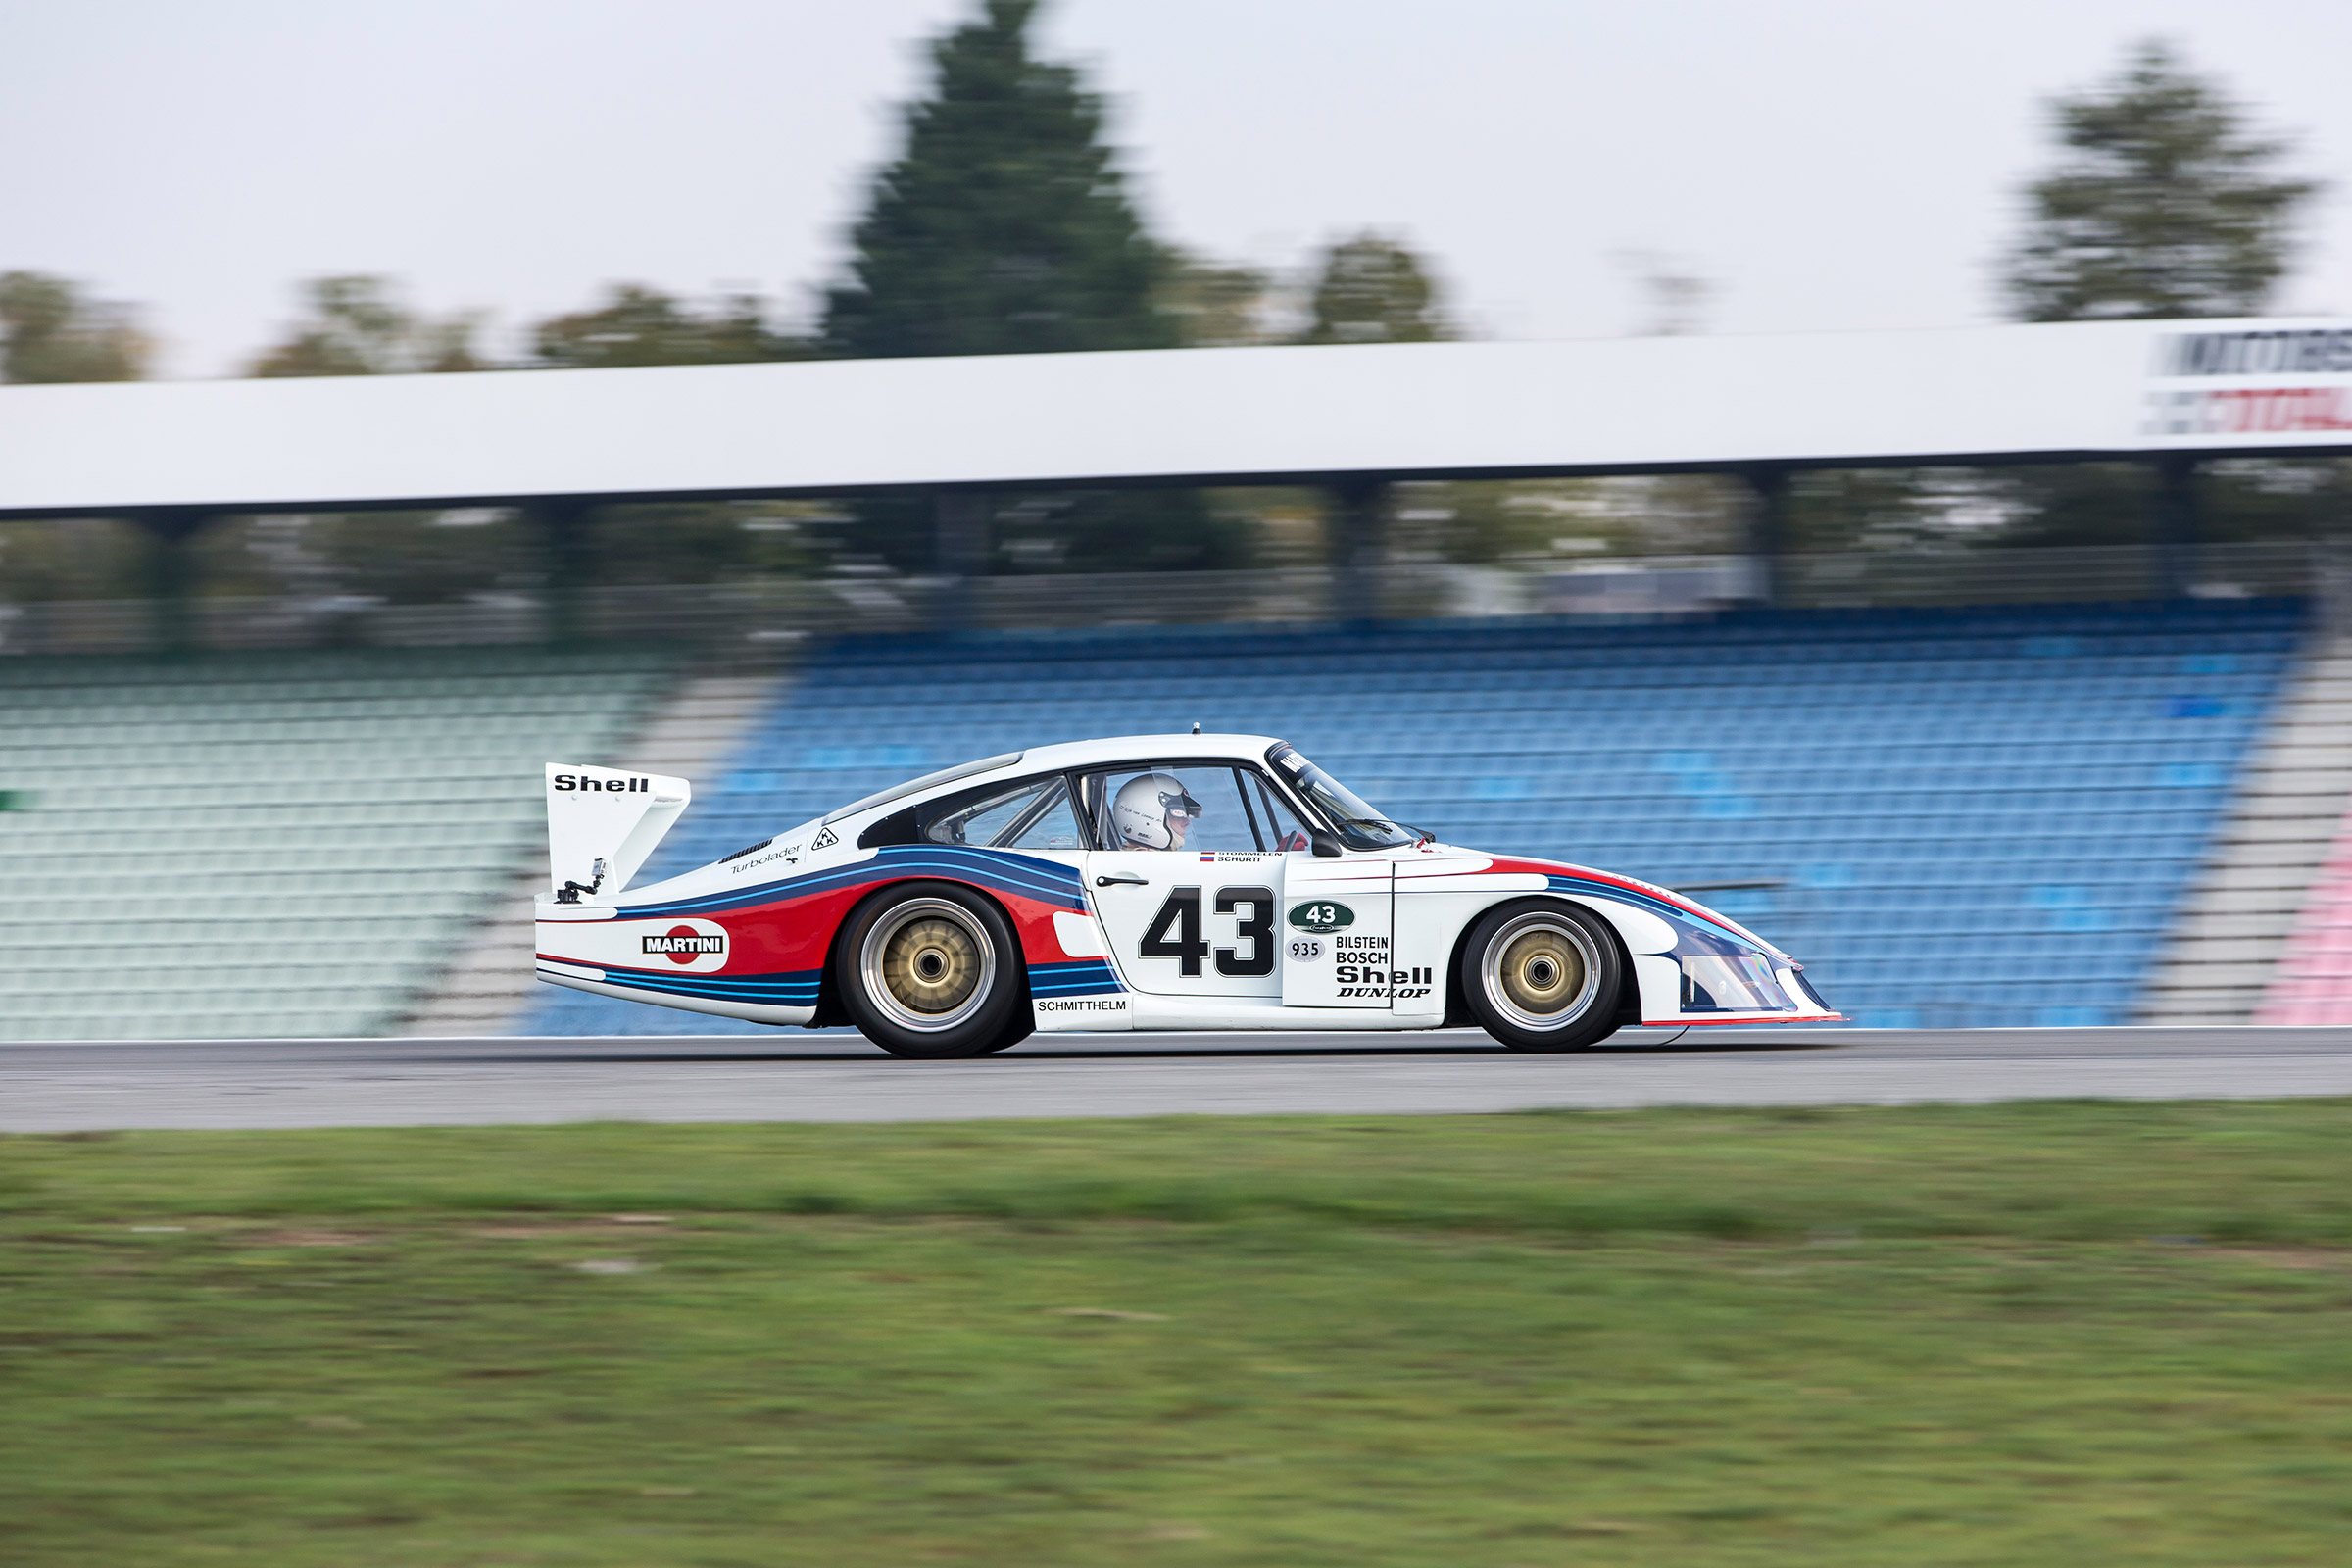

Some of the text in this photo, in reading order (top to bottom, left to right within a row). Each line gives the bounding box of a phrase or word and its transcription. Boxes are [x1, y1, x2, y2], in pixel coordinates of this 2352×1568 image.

[554, 774, 649, 793] Shell
[730, 844, 803, 874] Turbolader
[1305, 905, 1336, 924] 43
[1138, 885, 1276, 978] 43
[646, 937, 720, 953] MARTINI
[1292, 942, 1319, 956] 935
[1336, 936, 1389, 949] BILSTEIN
[1336, 952, 1389, 964] BOSCH
[1336, 965, 1433, 985] Shell
[1336, 987, 1432, 999] DUNLOP
[1038, 1001, 1127, 1012] SCHMITTHELM
